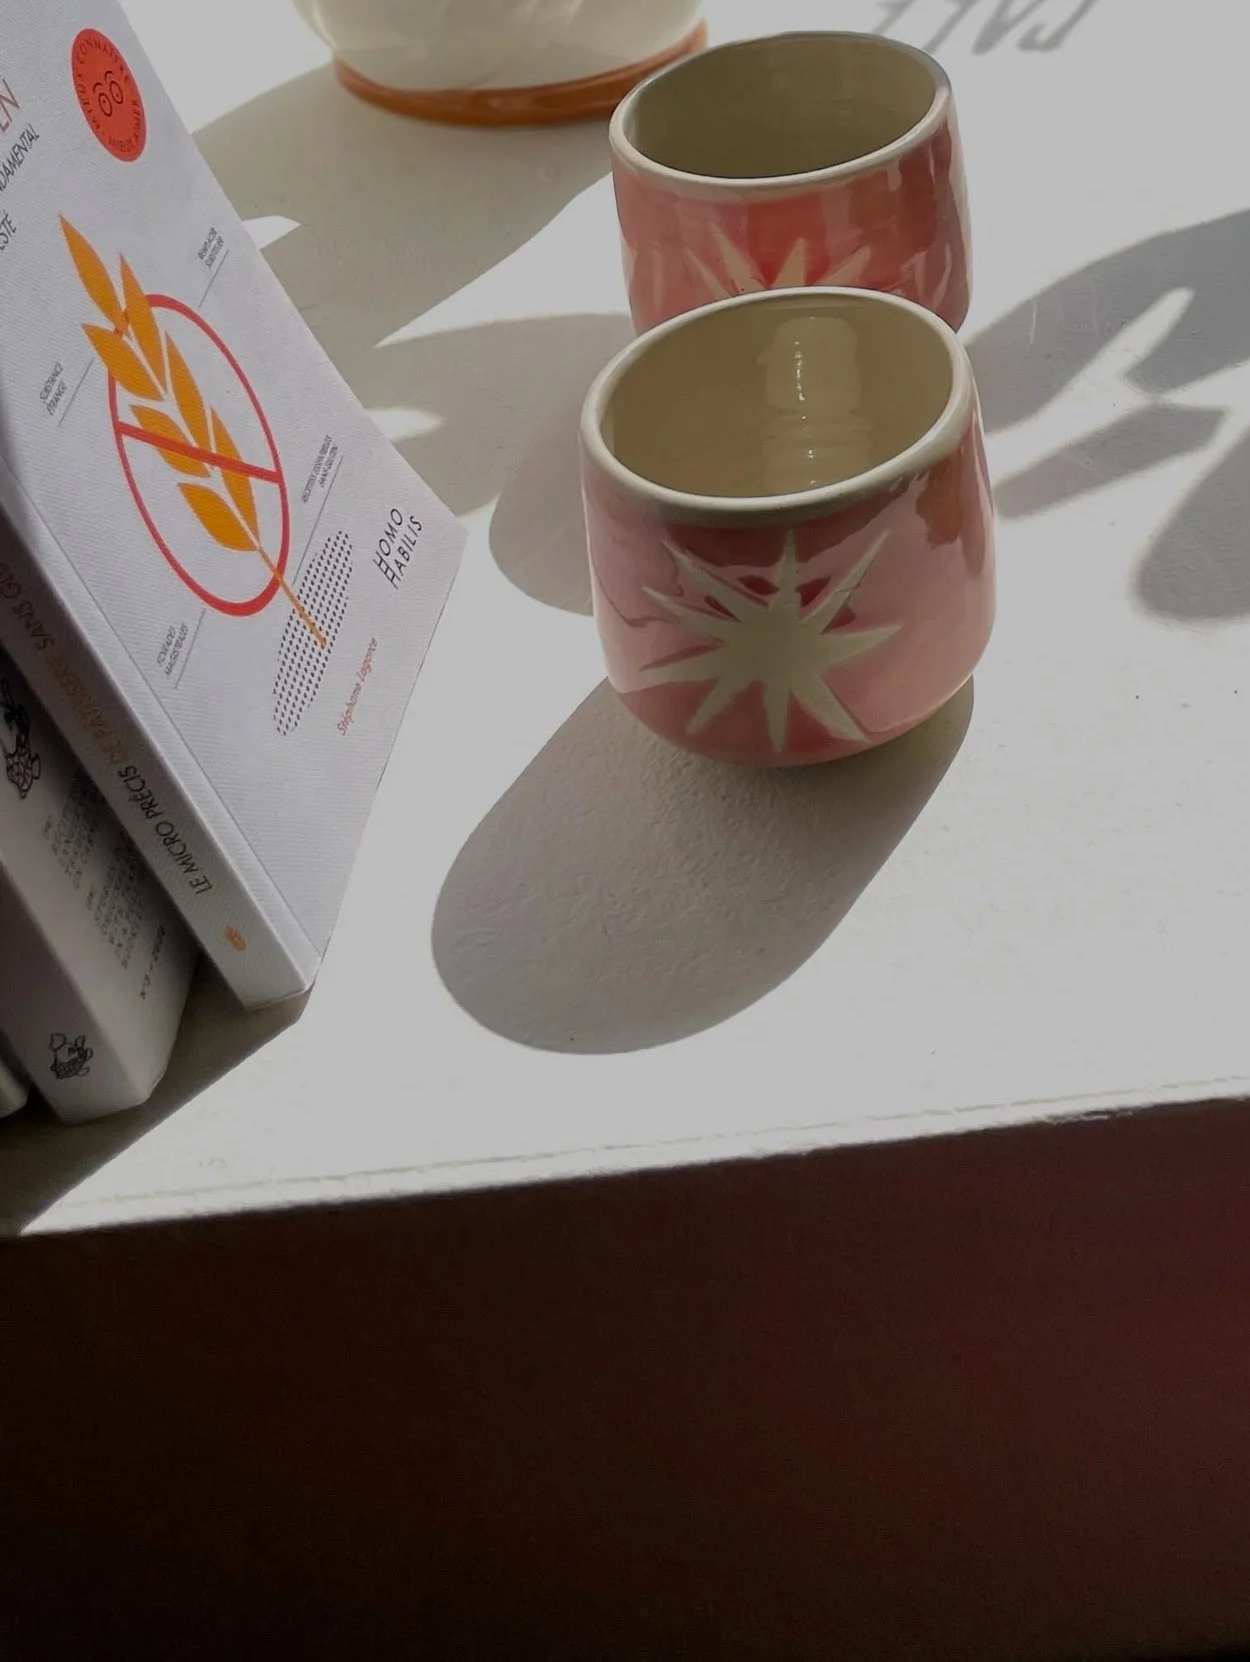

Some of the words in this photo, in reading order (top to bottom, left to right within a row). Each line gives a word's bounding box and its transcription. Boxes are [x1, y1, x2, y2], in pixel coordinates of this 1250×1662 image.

[0, 122, 40, 191] DAMENTAL
[373, 508, 403, 574] HOMO
[381, 515, 422, 590] HABILIS
[337, 682, 362, 736] Stéphane
[118, 765, 165, 819] PRÉCIS
[155, 821, 200, 874] MICRO
[189, 875, 213, 895] LE
